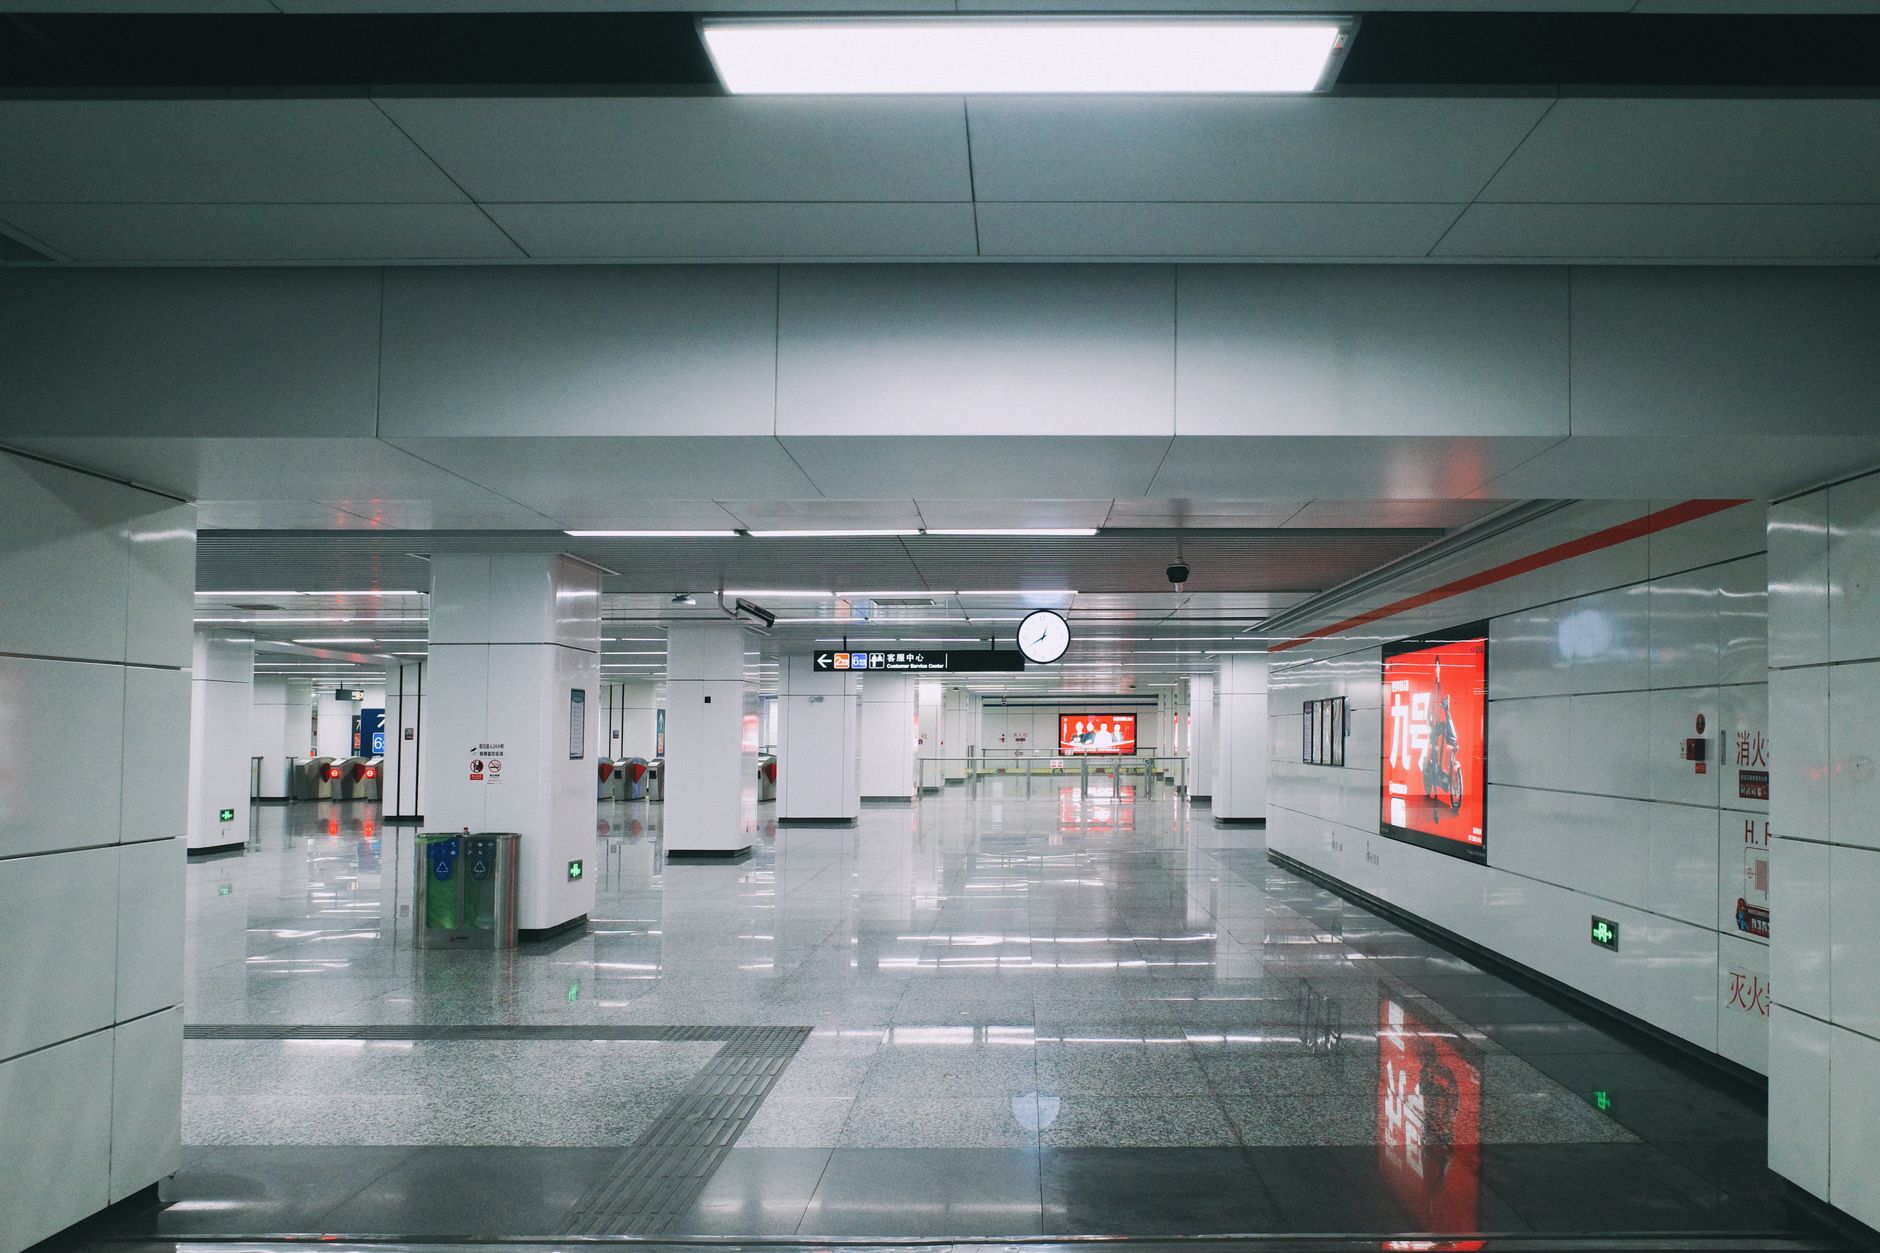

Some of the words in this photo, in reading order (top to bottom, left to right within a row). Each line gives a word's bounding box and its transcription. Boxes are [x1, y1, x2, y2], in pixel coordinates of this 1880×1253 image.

[887, 653, 924, 662] 客服中心
[1736, 730, 1769, 767] 消火
